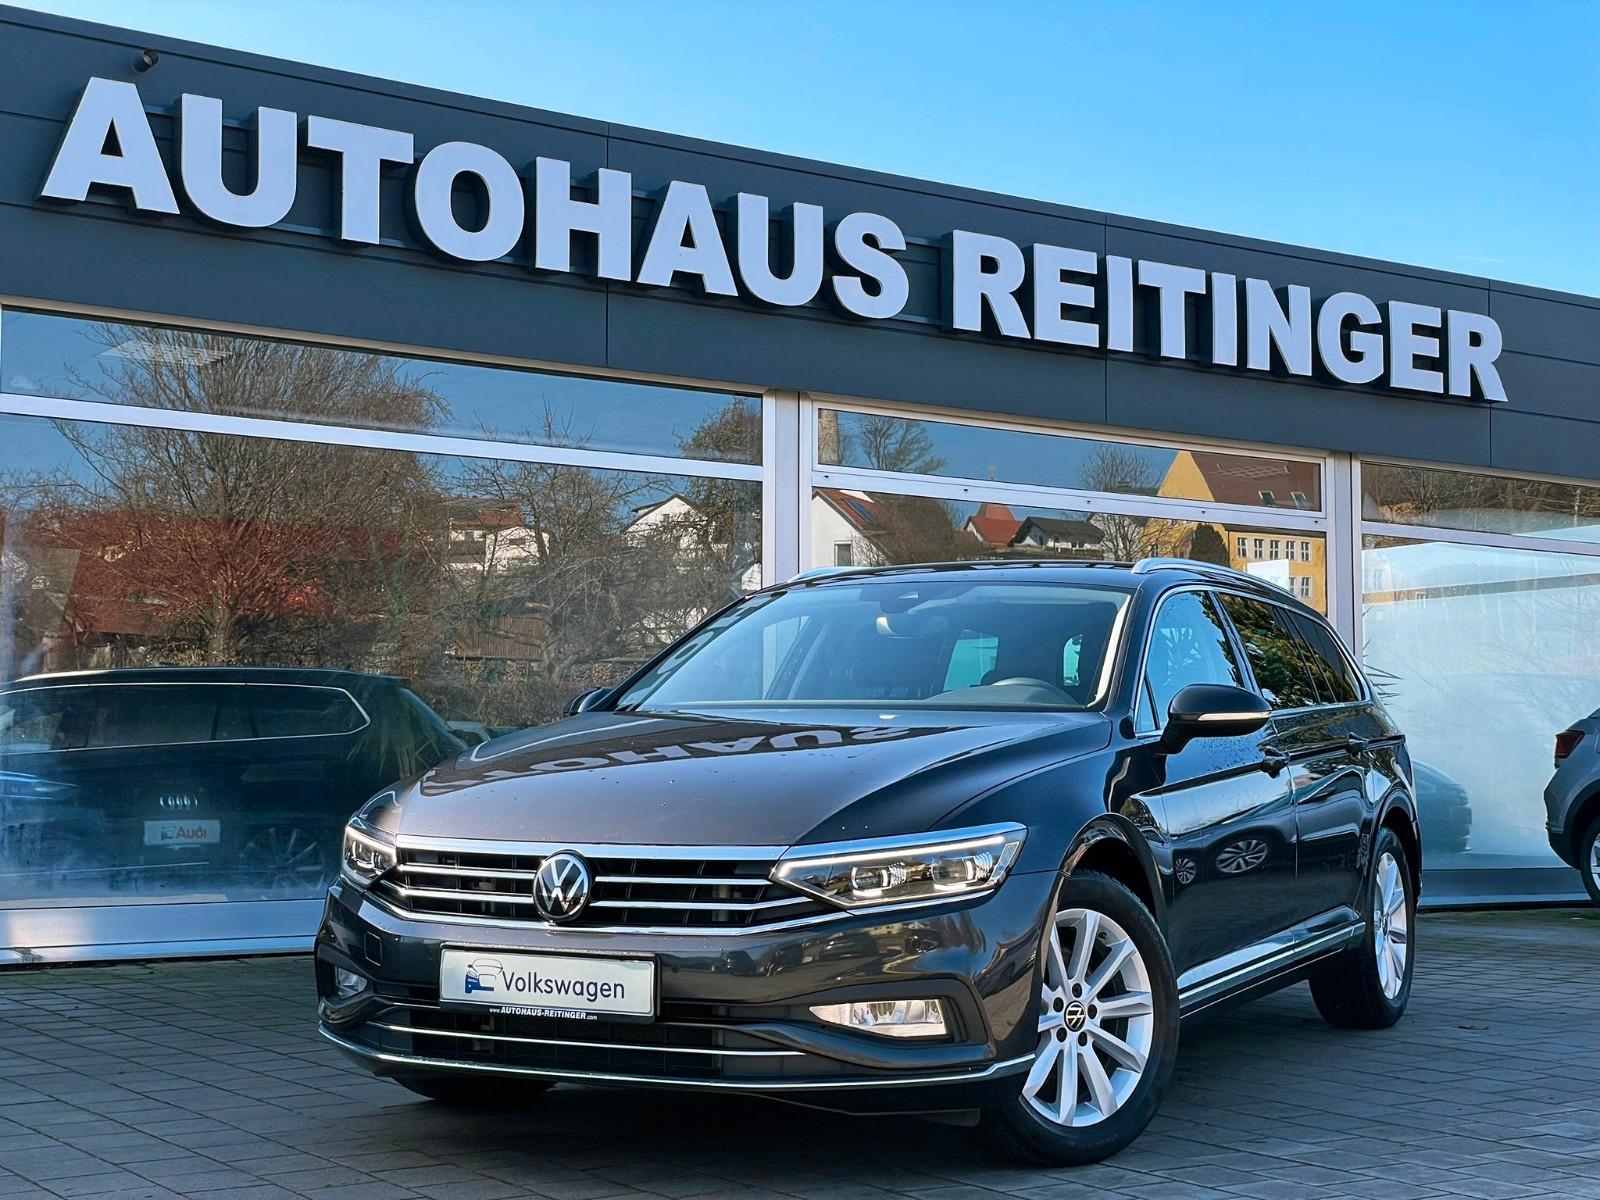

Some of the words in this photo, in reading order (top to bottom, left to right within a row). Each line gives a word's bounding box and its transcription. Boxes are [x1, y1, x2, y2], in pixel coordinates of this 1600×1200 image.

[41, 76, 909, 319] AUTOHAUS
[952, 229, 1508, 402] REITINGER
[176, 826, 207, 840] Audi
[535, 856, 587, 915] VW
[502, 971, 625, 1002] Volkswagen
